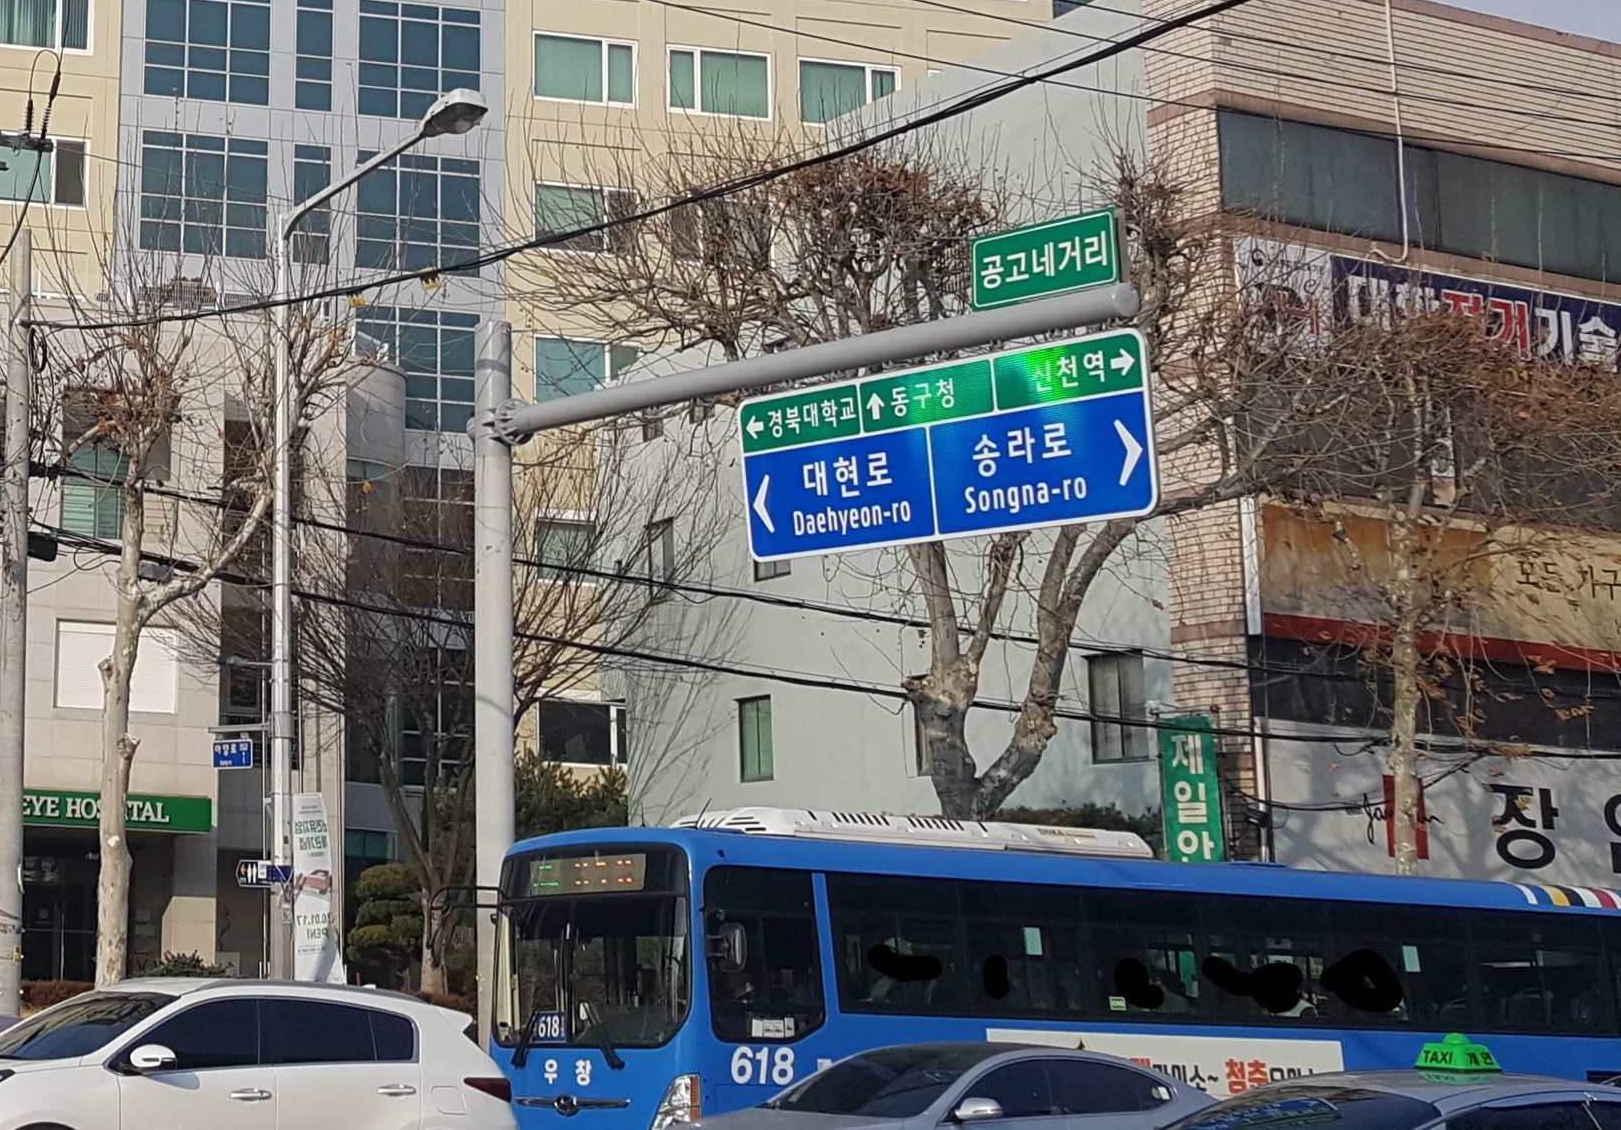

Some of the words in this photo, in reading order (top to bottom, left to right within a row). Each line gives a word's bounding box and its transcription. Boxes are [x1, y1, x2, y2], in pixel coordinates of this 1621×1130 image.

[980, 230, 1109, 289] 공고네거리
[1032, 350, 1106, 393] 신천역
[767, 396, 857, 438] 경북대학교
[890, 378, 956, 419] 동구청
[971, 421, 1073, 478] 송라로
[802, 452, 893, 498] 대현로
[964, 476, 1087, 515] Songna-ro
[792, 498, 912, 537] Daehyeon-ro
[22, 794, 60, 817] EYE
[65, 797, 170, 823] HOTAL
[537, 1014, 560, 1038] 618
[544, 1059, 592, 1086] 우창
[731, 1046, 795, 1085] 618
[1423, 1049, 1454, 1065] TAXI
[1465, 1051, 1495, 1066] 개인
